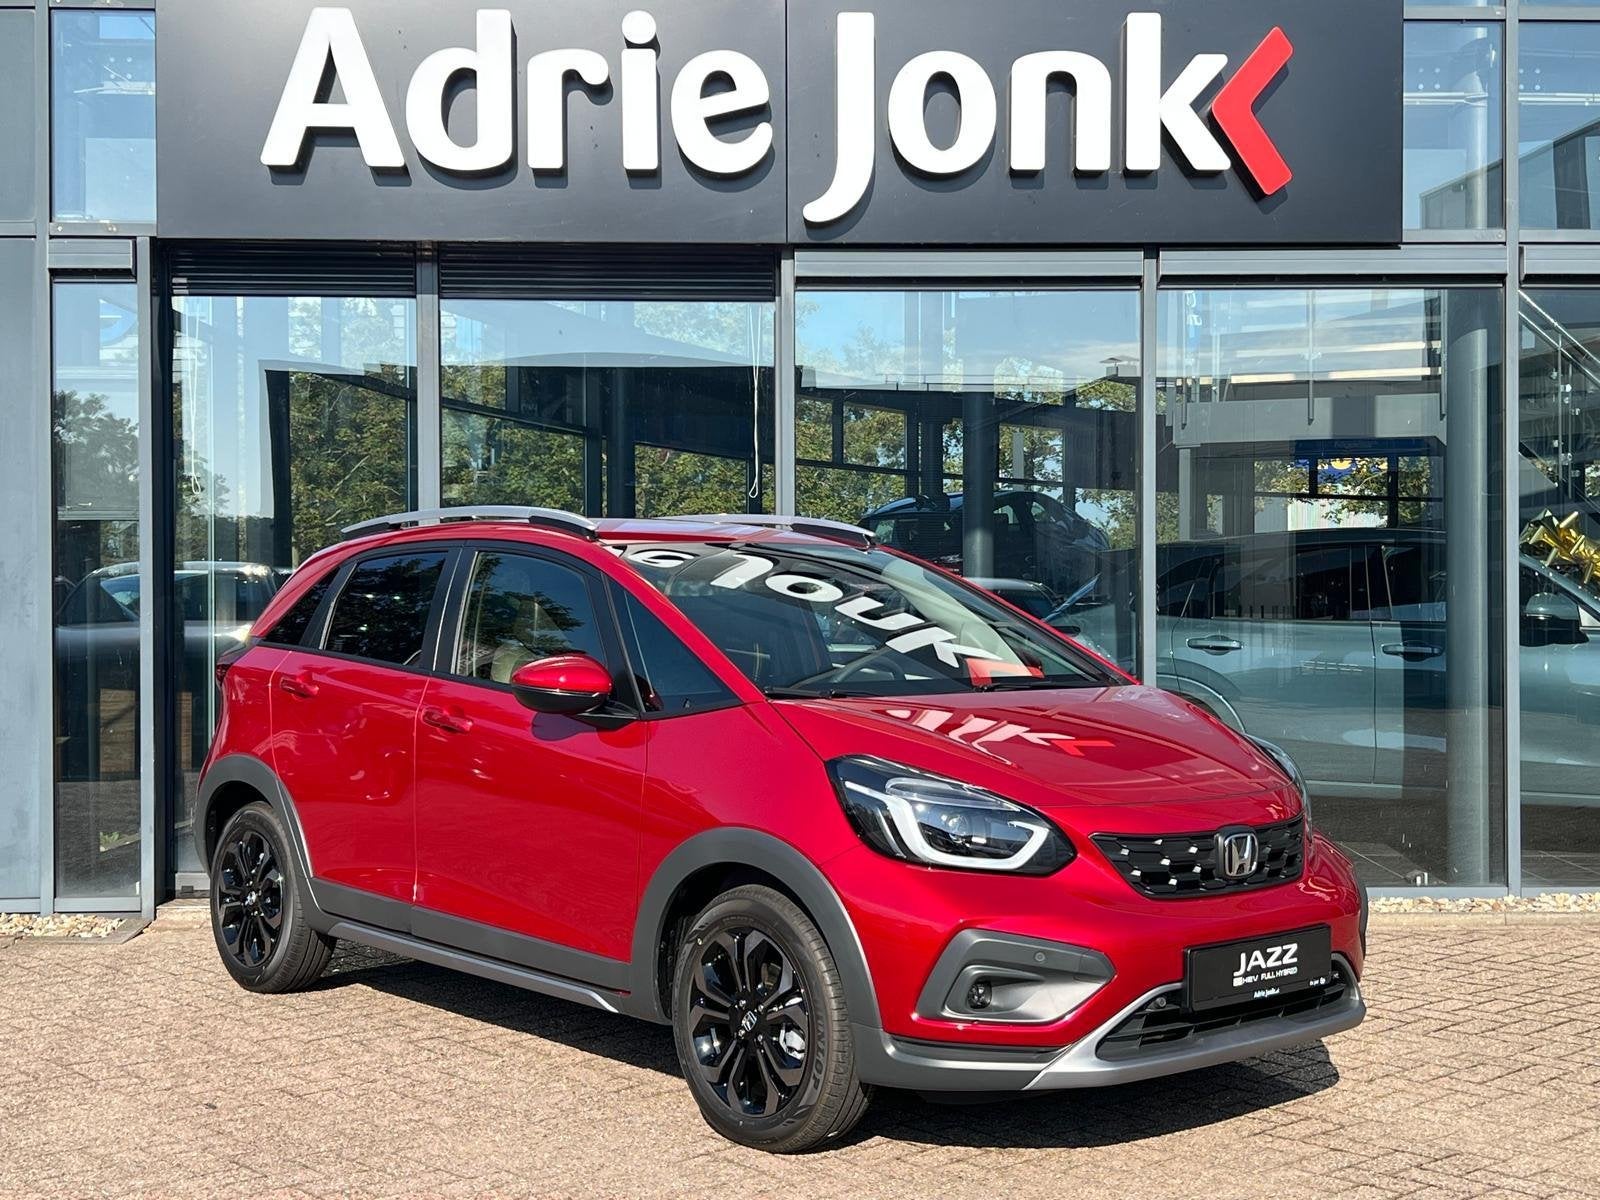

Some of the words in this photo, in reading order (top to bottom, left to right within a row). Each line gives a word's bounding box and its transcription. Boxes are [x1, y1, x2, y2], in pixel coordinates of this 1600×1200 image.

[260, 8, 774, 174] Adrie
[802, 12, 1230, 223] Jonk
[1233, 943, 1298, 977] JAZZ
[1260, 971, 1276, 981] FULL
